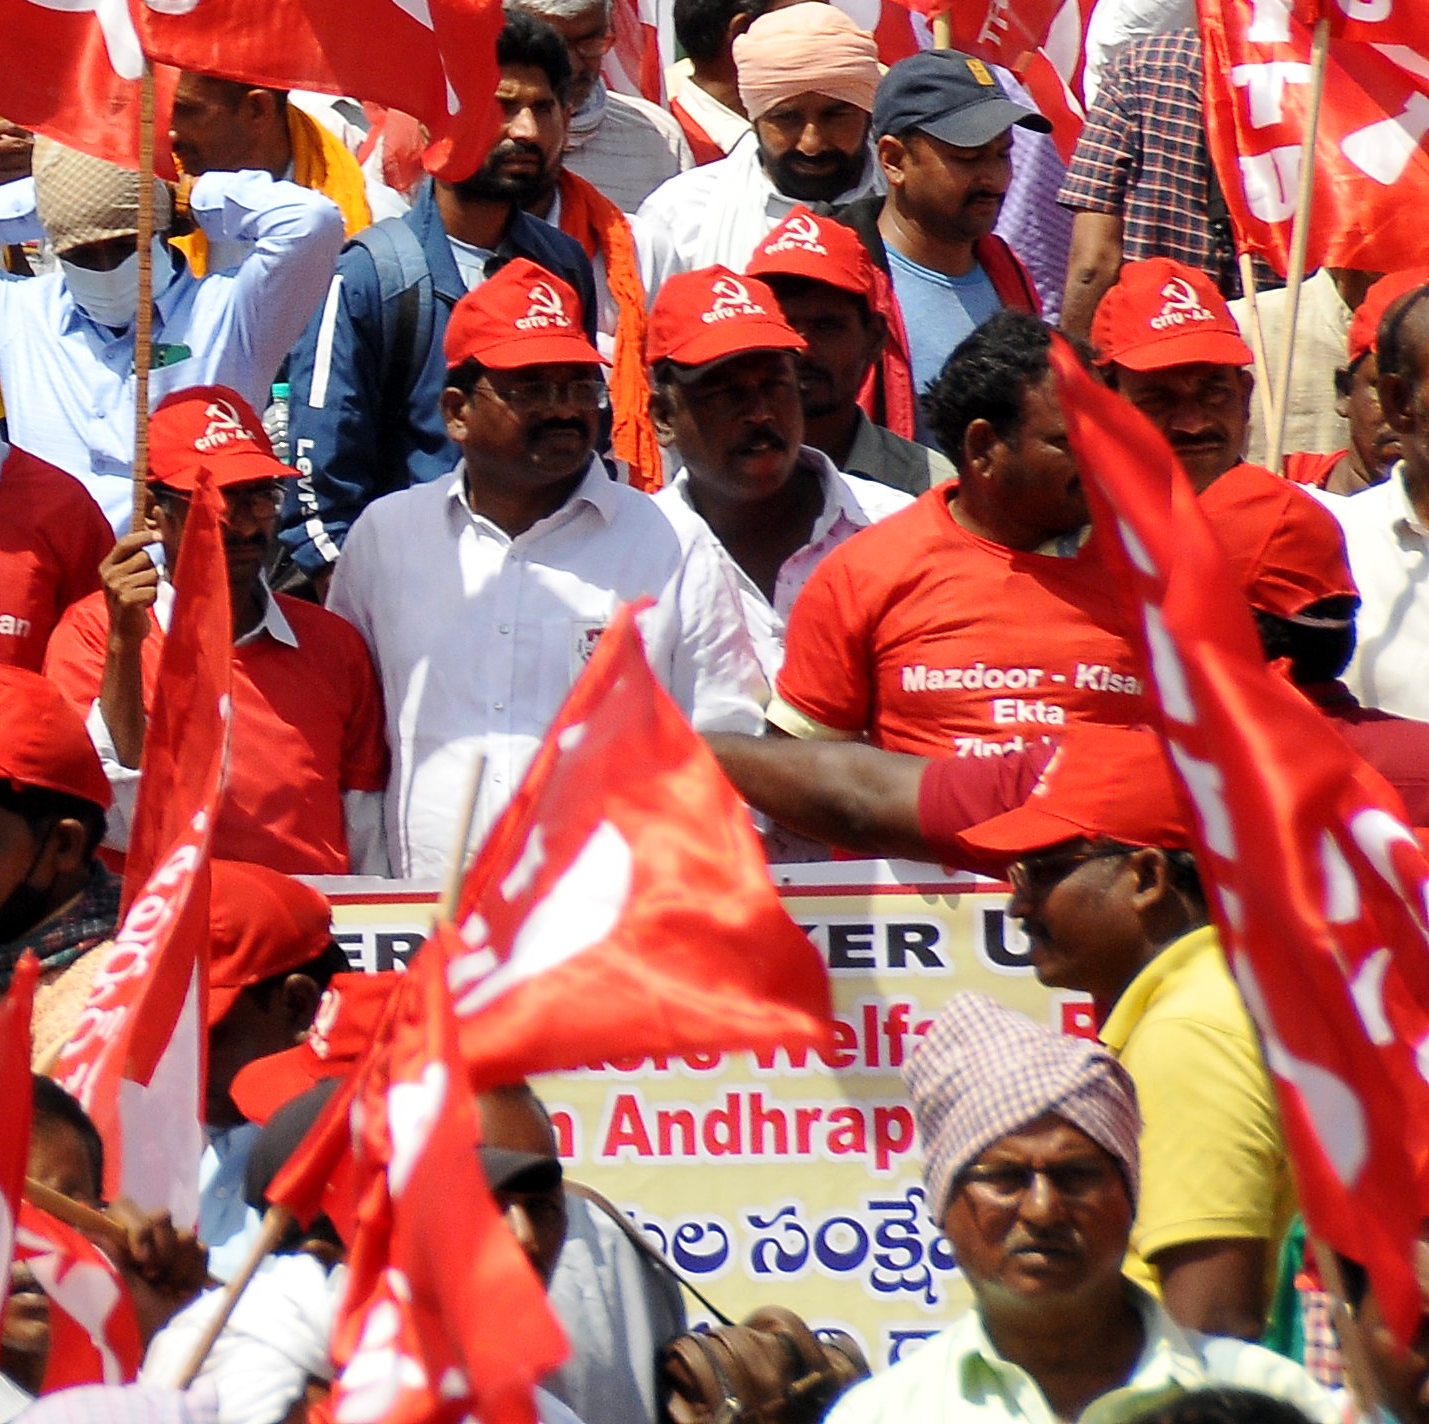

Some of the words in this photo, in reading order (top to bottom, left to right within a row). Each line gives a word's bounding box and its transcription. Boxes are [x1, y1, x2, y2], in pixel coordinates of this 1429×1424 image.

[296, 438, 319, 516] Levi
[901, 663, 1044, 693] Mazdoor
[1073, 663, 1145, 697] Kisa
[993, 698, 1065, 726] Ekta
[602, 1092, 915, 1171] Andhrap
[747, 1187, 959, 1305] సంక్షే
